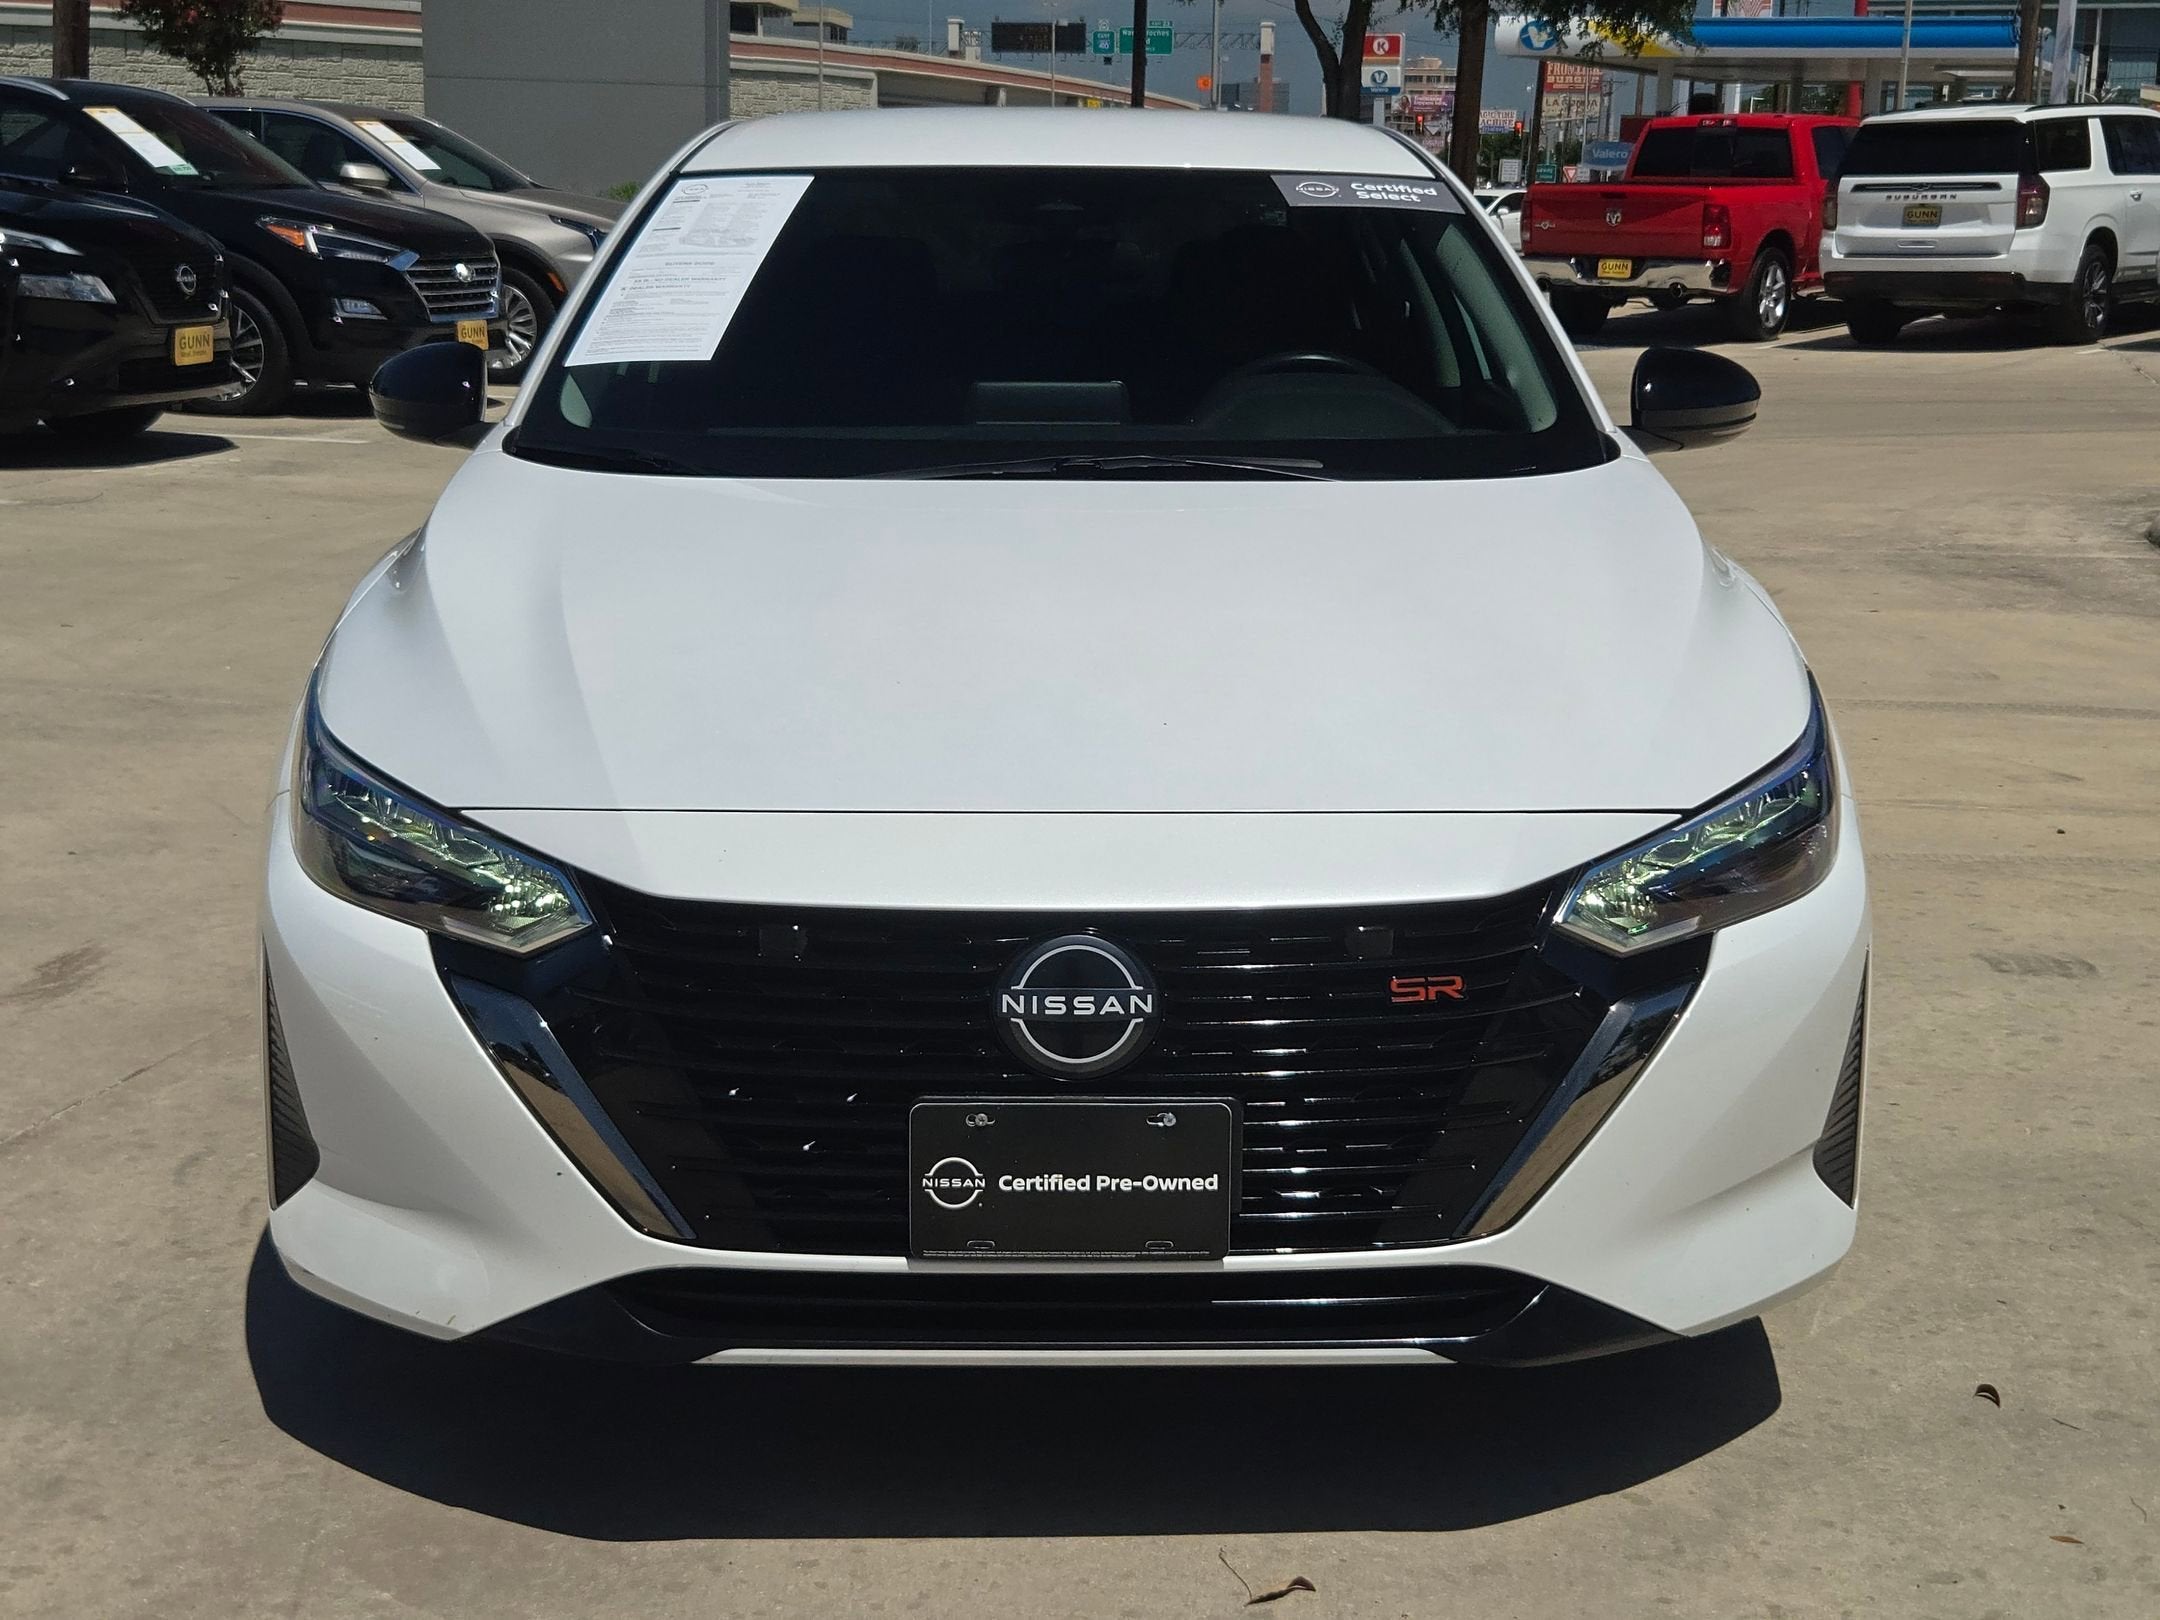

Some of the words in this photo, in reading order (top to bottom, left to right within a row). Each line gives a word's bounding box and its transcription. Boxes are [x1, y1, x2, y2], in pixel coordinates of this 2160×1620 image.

[1376, 41, 1386, 52] K
[1479, 119, 1515, 127] ACHINE
[1592, 148, 1628, 159] Valero
[1350, 182, 1437, 196] Certified
[1356, 191, 1421, 203] Select
[1906, 210, 1938, 219] GUNN
[1601, 262, 1629, 271] GUNN
[461, 326, 485, 339] GUNN
[179, 334, 210, 350] GUNN
[1390, 975, 1464, 1003] SR
[1002, 993, 1152, 1015] NISSAN
[922, 1177, 985, 1189] NISSAN
[998, 1173, 1091, 1192] Certified
[1096, 1173, 1218, 1192] Pre-Owned
